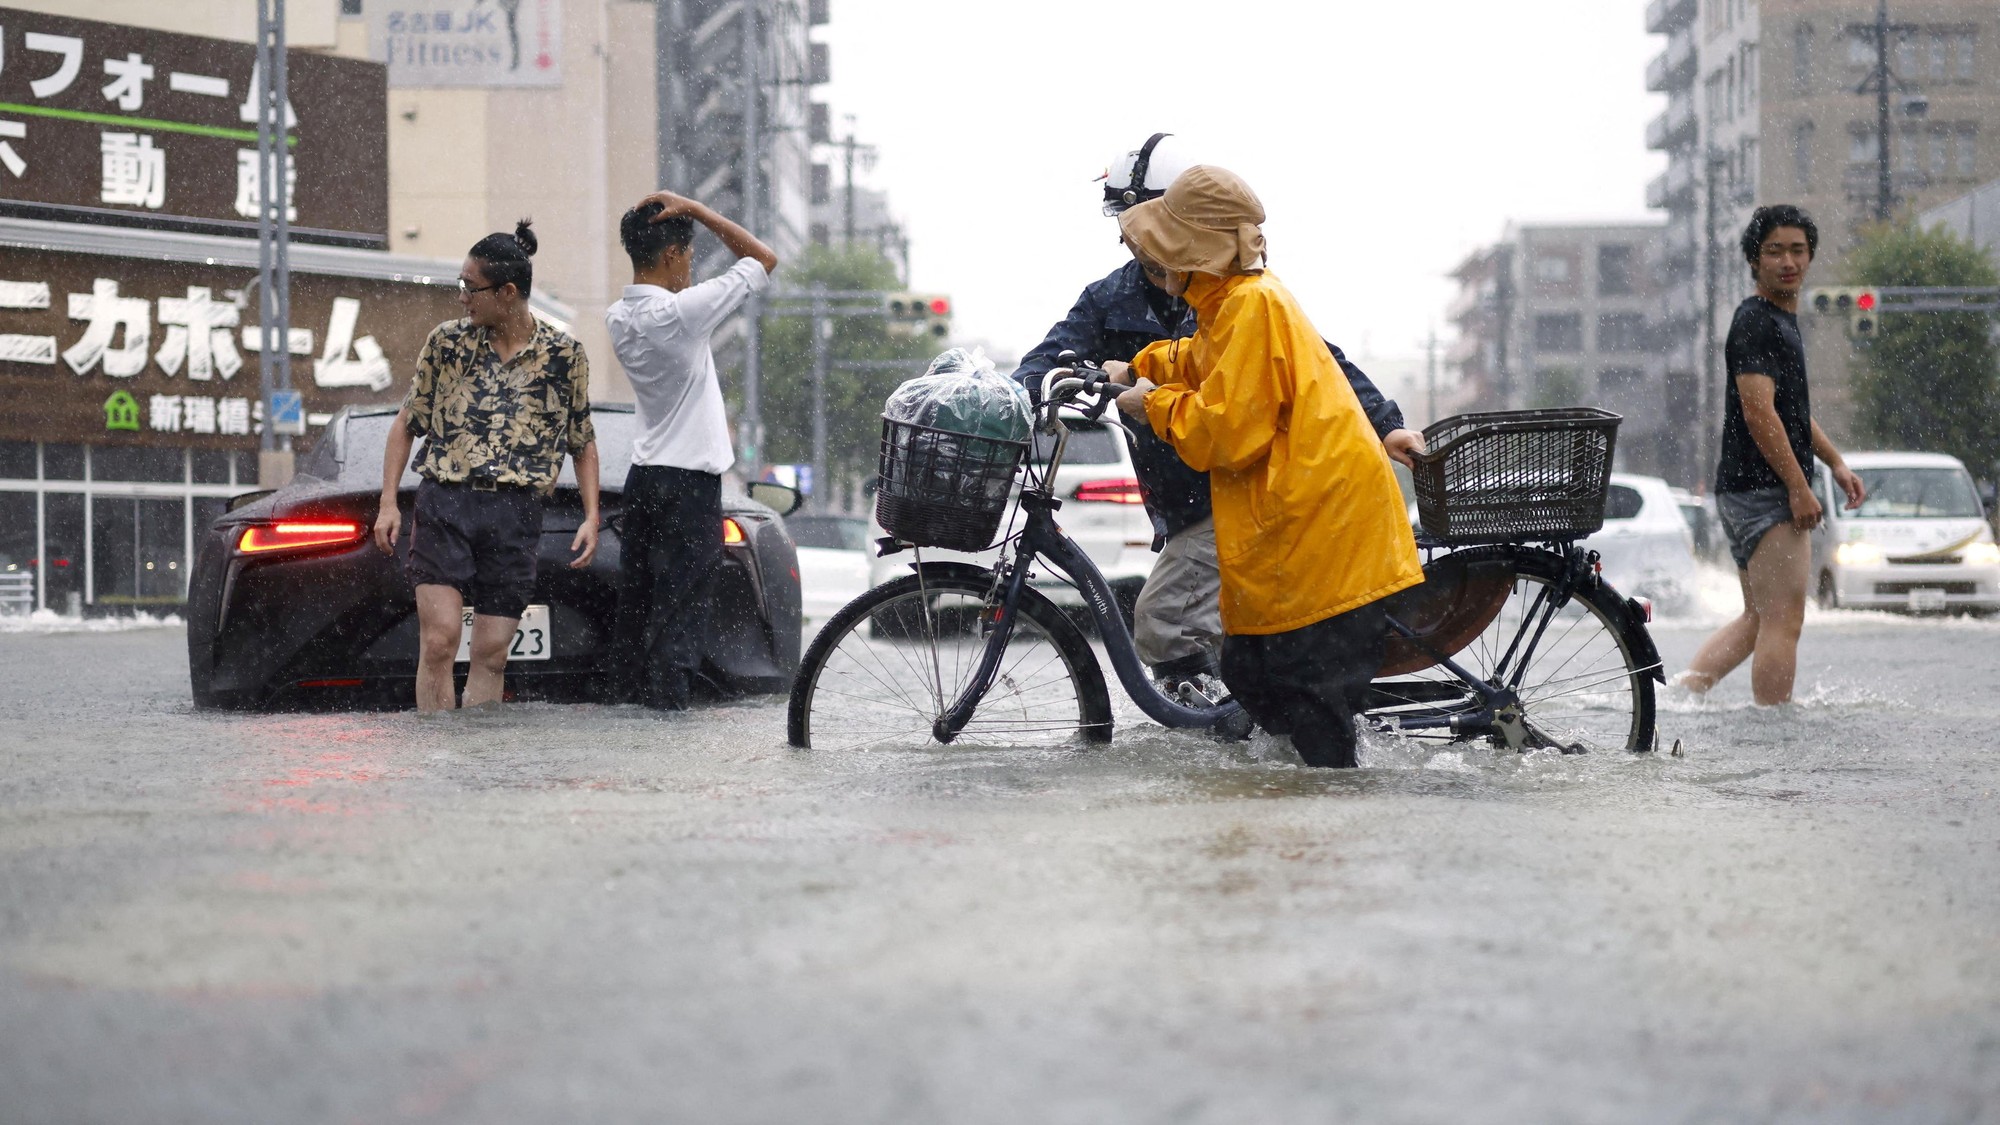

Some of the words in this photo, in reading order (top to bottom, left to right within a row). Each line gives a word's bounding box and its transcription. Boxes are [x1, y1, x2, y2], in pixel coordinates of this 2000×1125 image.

[386, 36, 501, 66] Fitness
[0, 26, 298, 128] フォーム
[1093, 592, 1108, 615] with
[510, 628, 544, 656] 23
